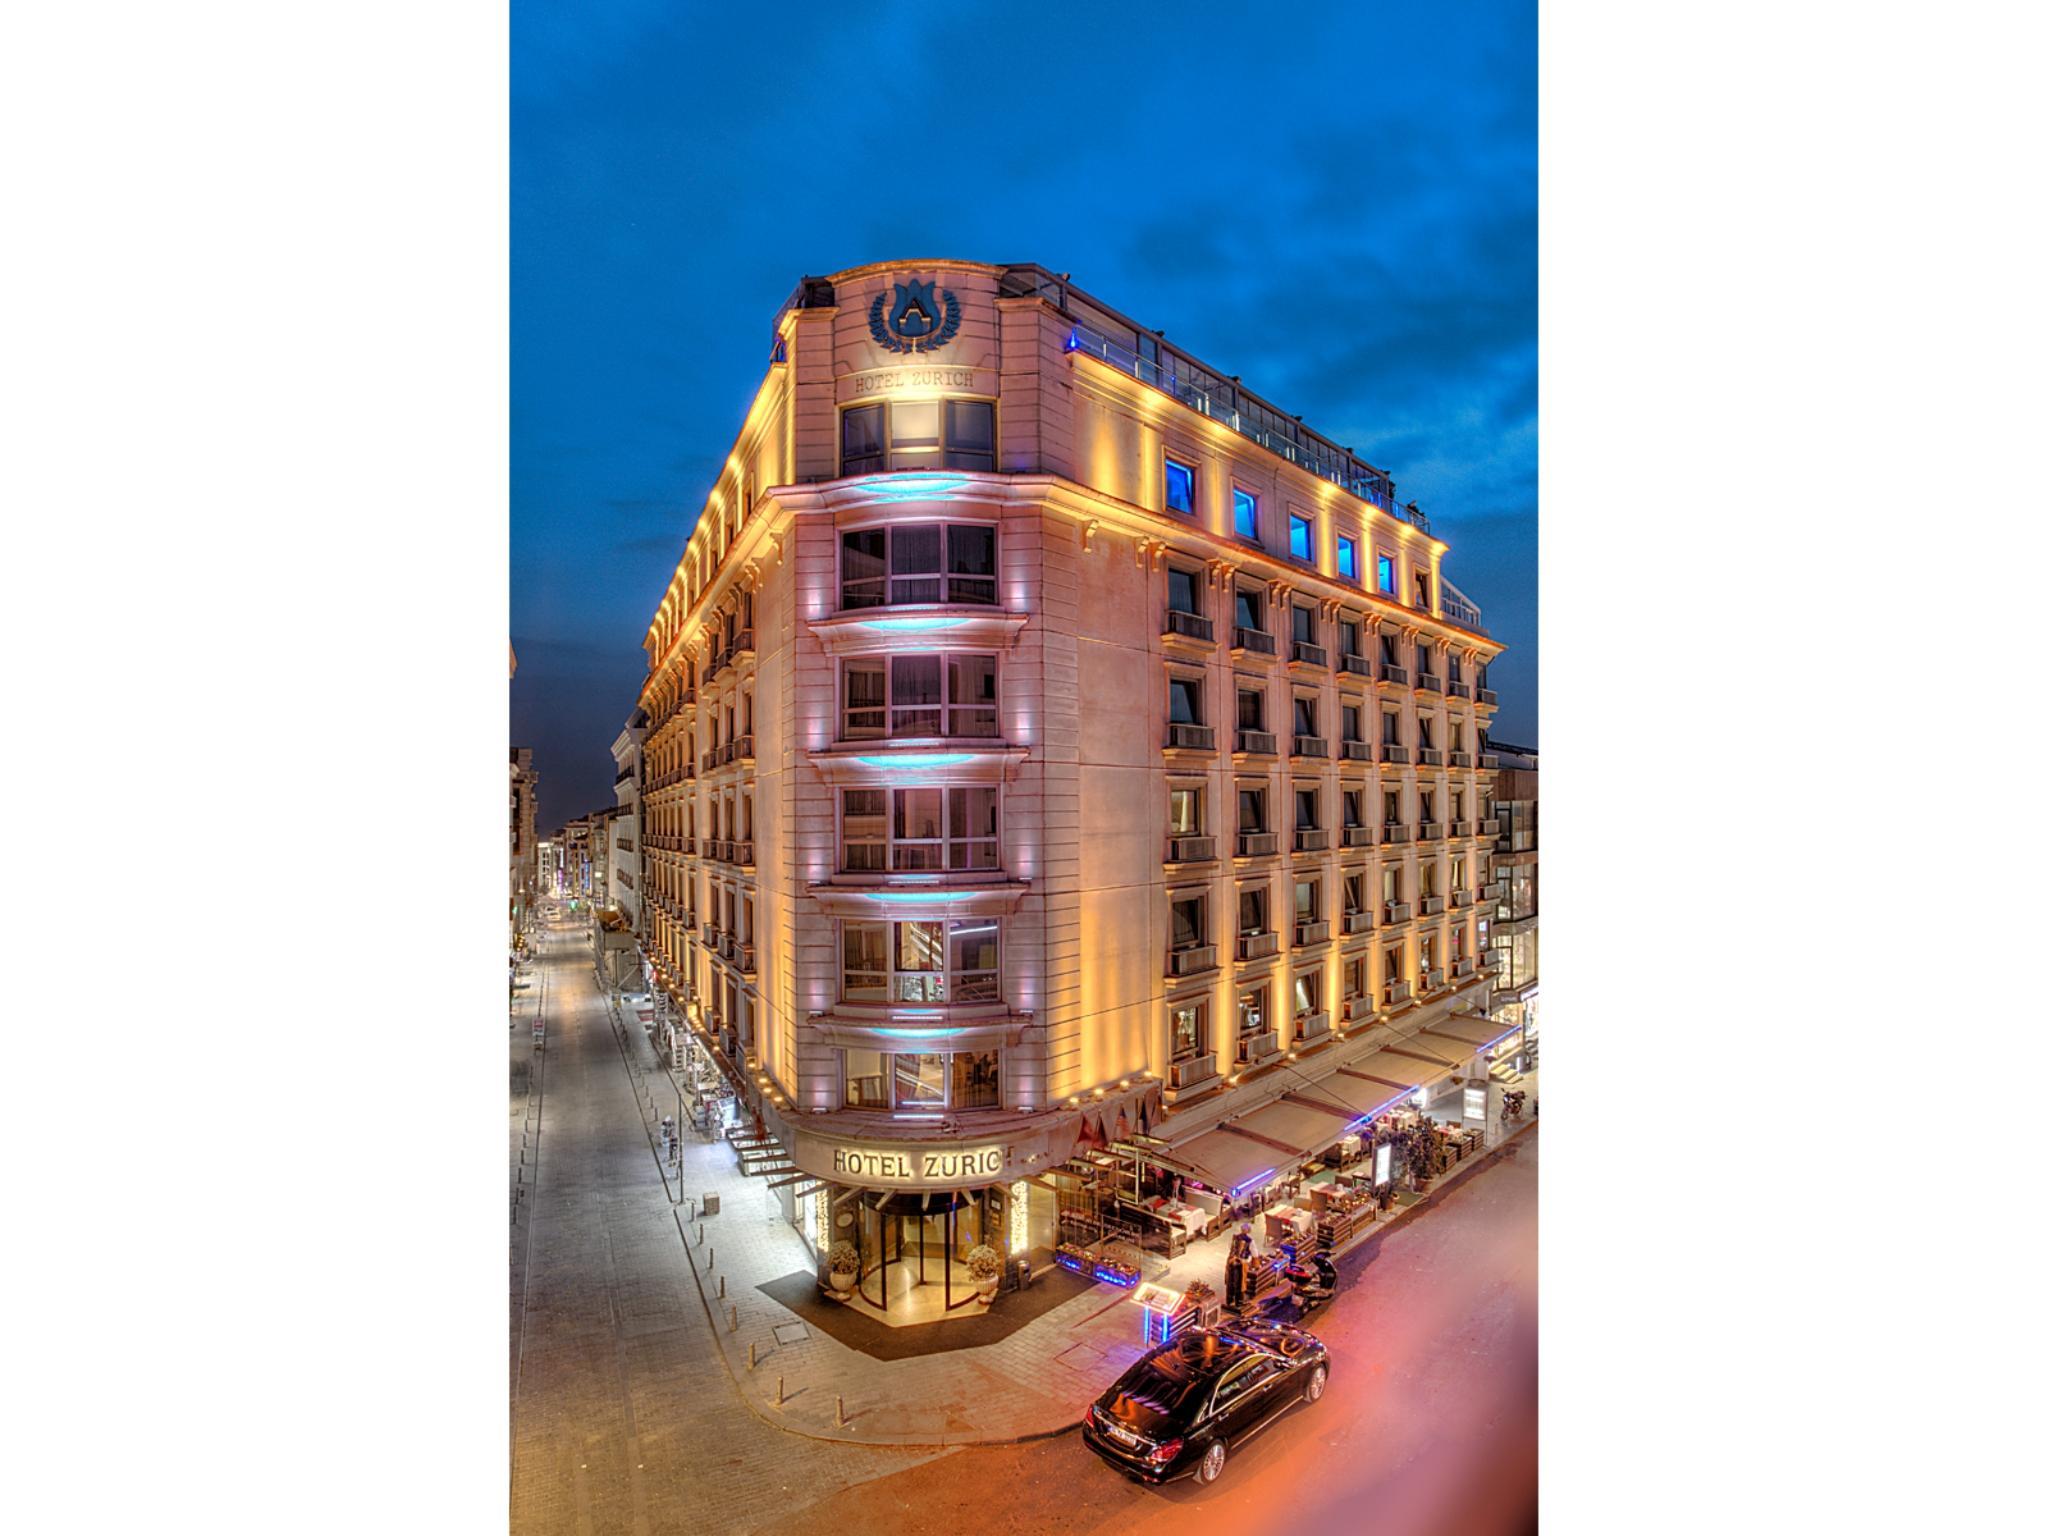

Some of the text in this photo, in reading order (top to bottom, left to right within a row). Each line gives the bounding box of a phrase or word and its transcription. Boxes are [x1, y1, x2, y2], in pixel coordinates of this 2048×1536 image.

[855, 371, 975, 393] HOTEL ZURICH
[833, 1149, 910, 1178] HOTEL
